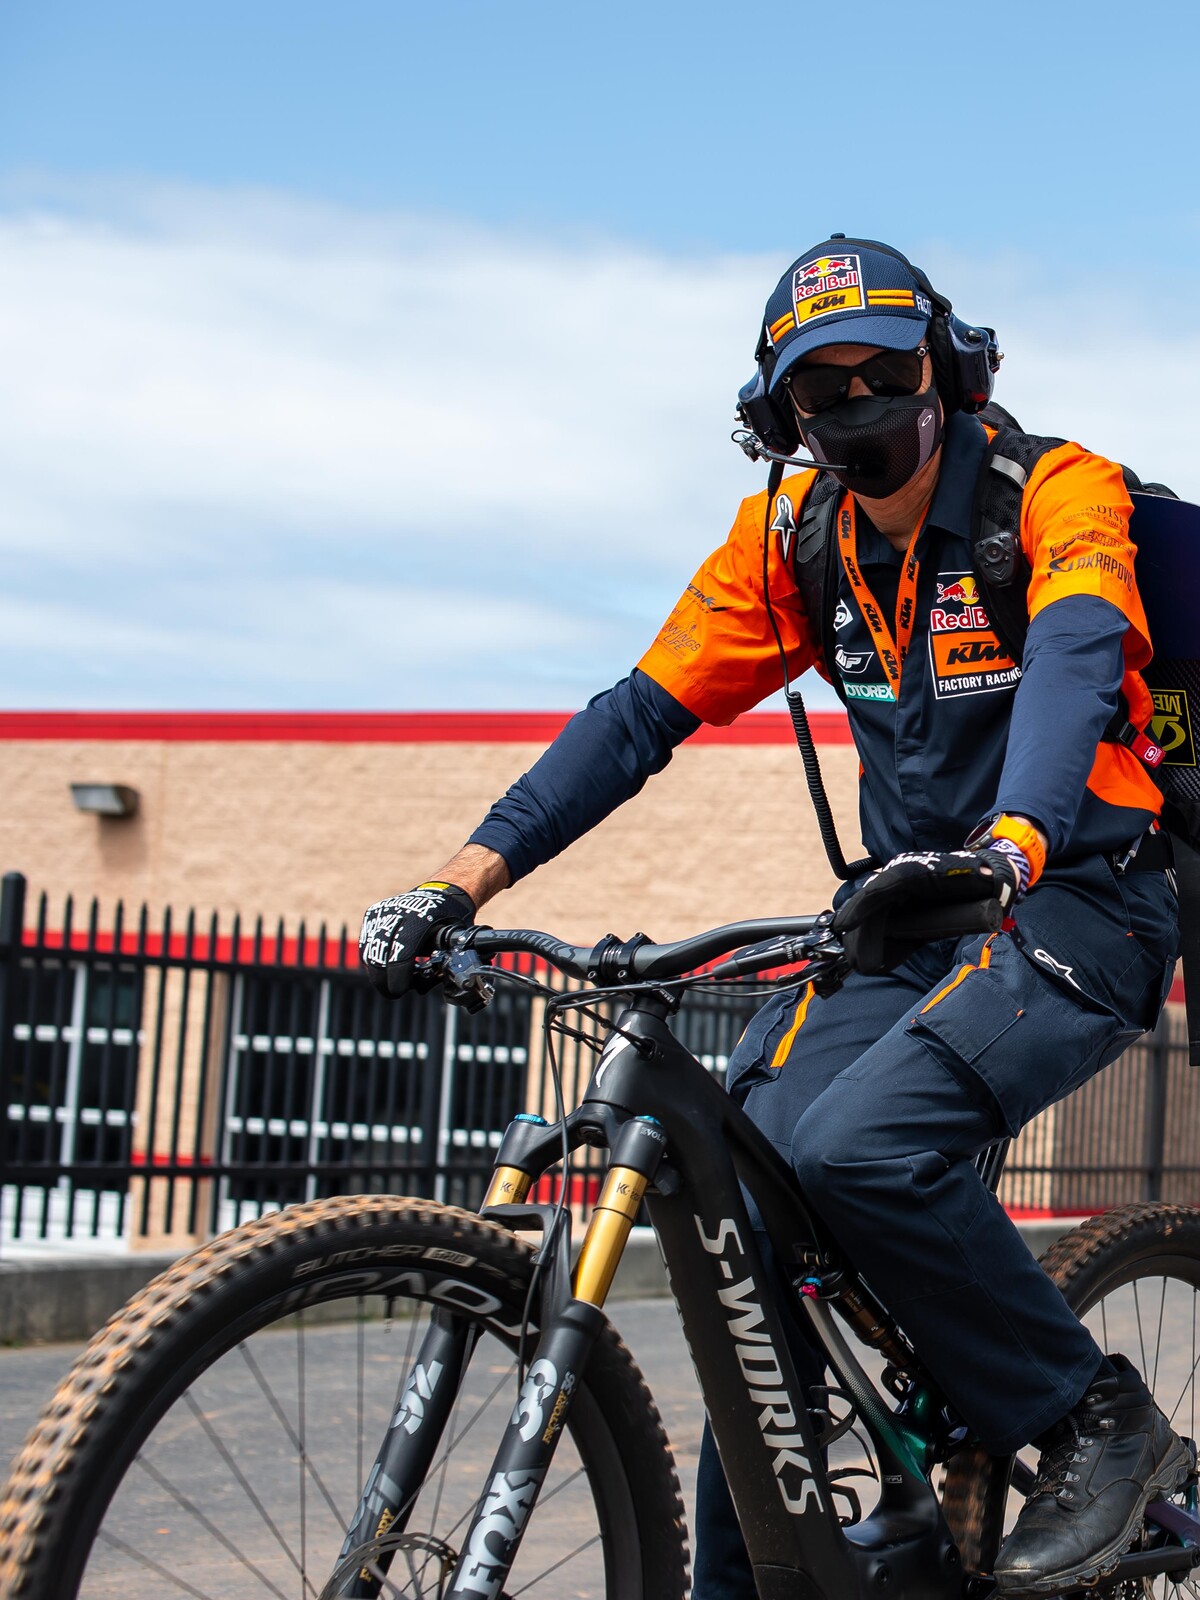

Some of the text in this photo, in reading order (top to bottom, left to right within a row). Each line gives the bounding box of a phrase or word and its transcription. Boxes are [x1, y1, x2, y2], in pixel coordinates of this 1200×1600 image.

[796, 271, 858, 300] Red Bull
[810, 294, 846, 313] KTM
[841, 509, 850, 539] KTM
[845, 556, 861, 587] KTM
[864, 603, 883, 633] KTM
[900, 597, 913, 630] KTM
[931, 606, 971, 631] Red
[882, 649, 899, 680] KTM
[946, 641, 1010, 665] KTM
[939, 666, 1023, 692] FACTORY RACING
[291, 1245, 424, 1279] BUTCHER
[693, 1214, 825, 1515] S-WORKS
[512, 1358, 558, 1442] 36
[542, 1370, 576, 1444] FACTORY 36
